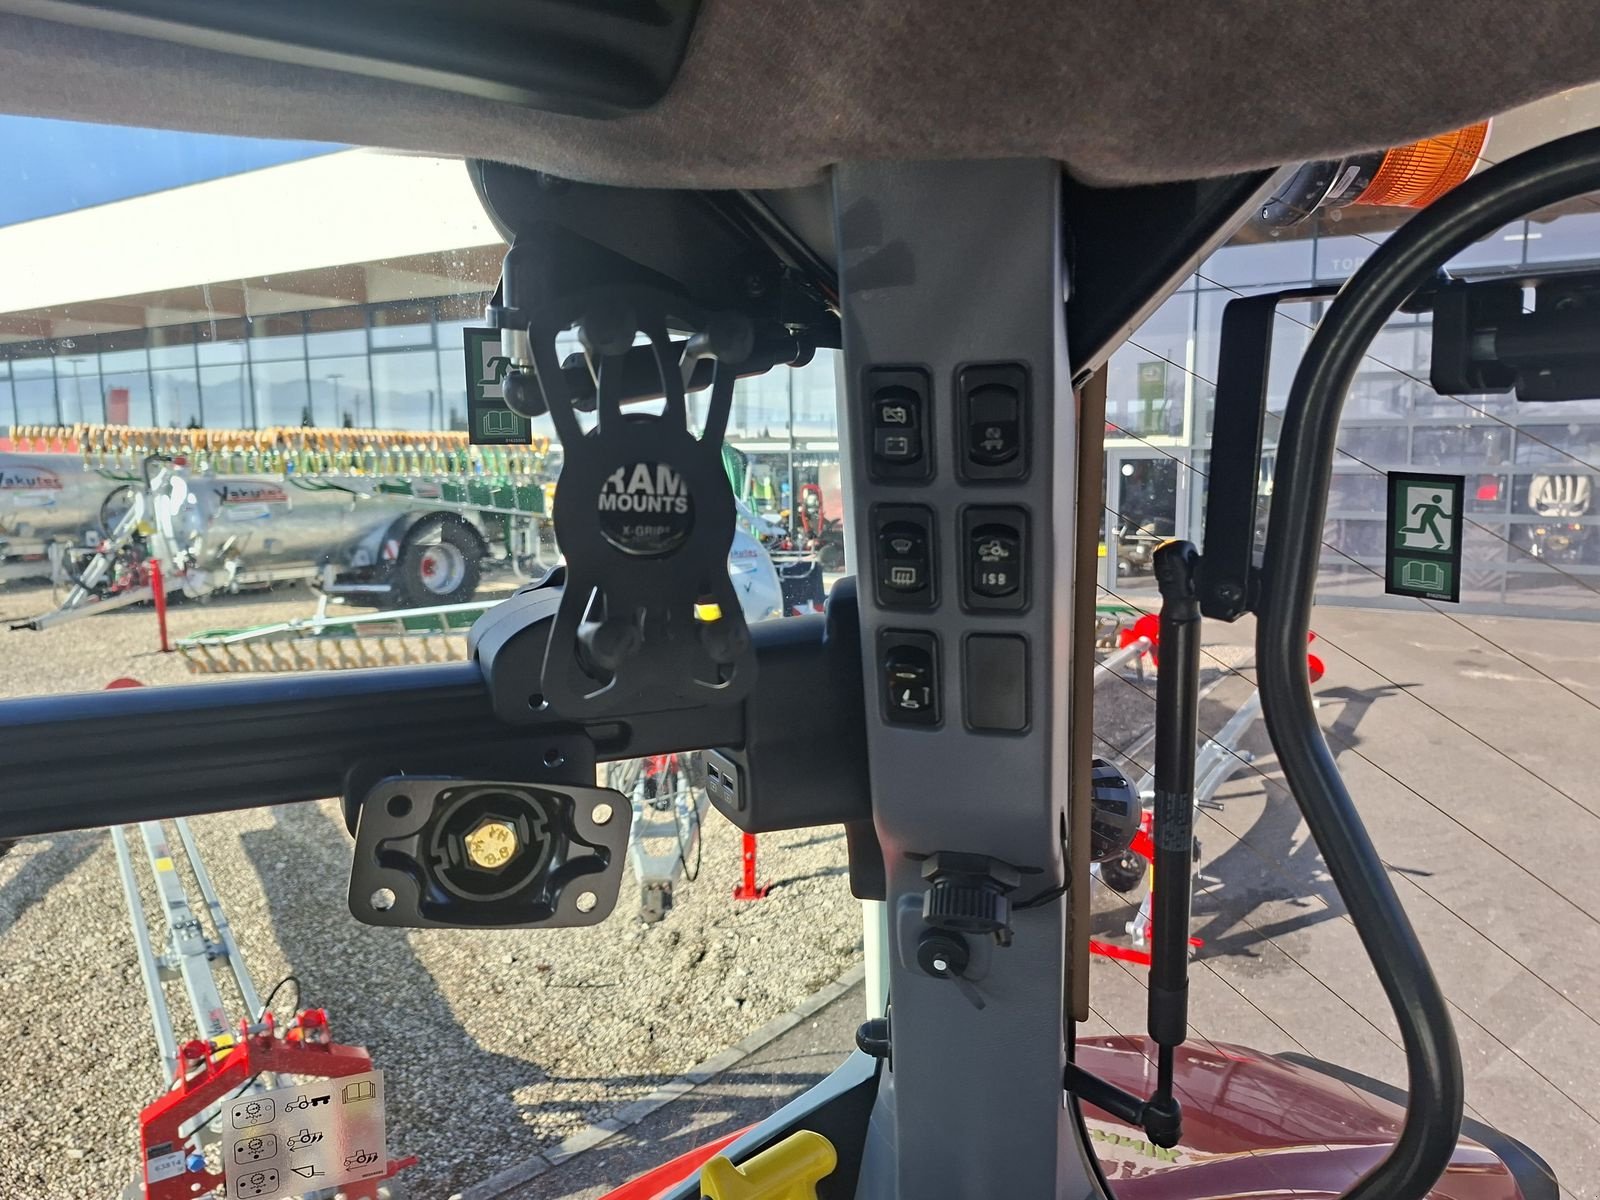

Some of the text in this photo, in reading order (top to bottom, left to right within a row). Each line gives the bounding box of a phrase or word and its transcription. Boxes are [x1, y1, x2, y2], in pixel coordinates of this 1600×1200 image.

[601, 463, 688, 496] RAM
[598, 493, 688, 513] MOUNTS
[982, 573, 1006, 585] ISB
